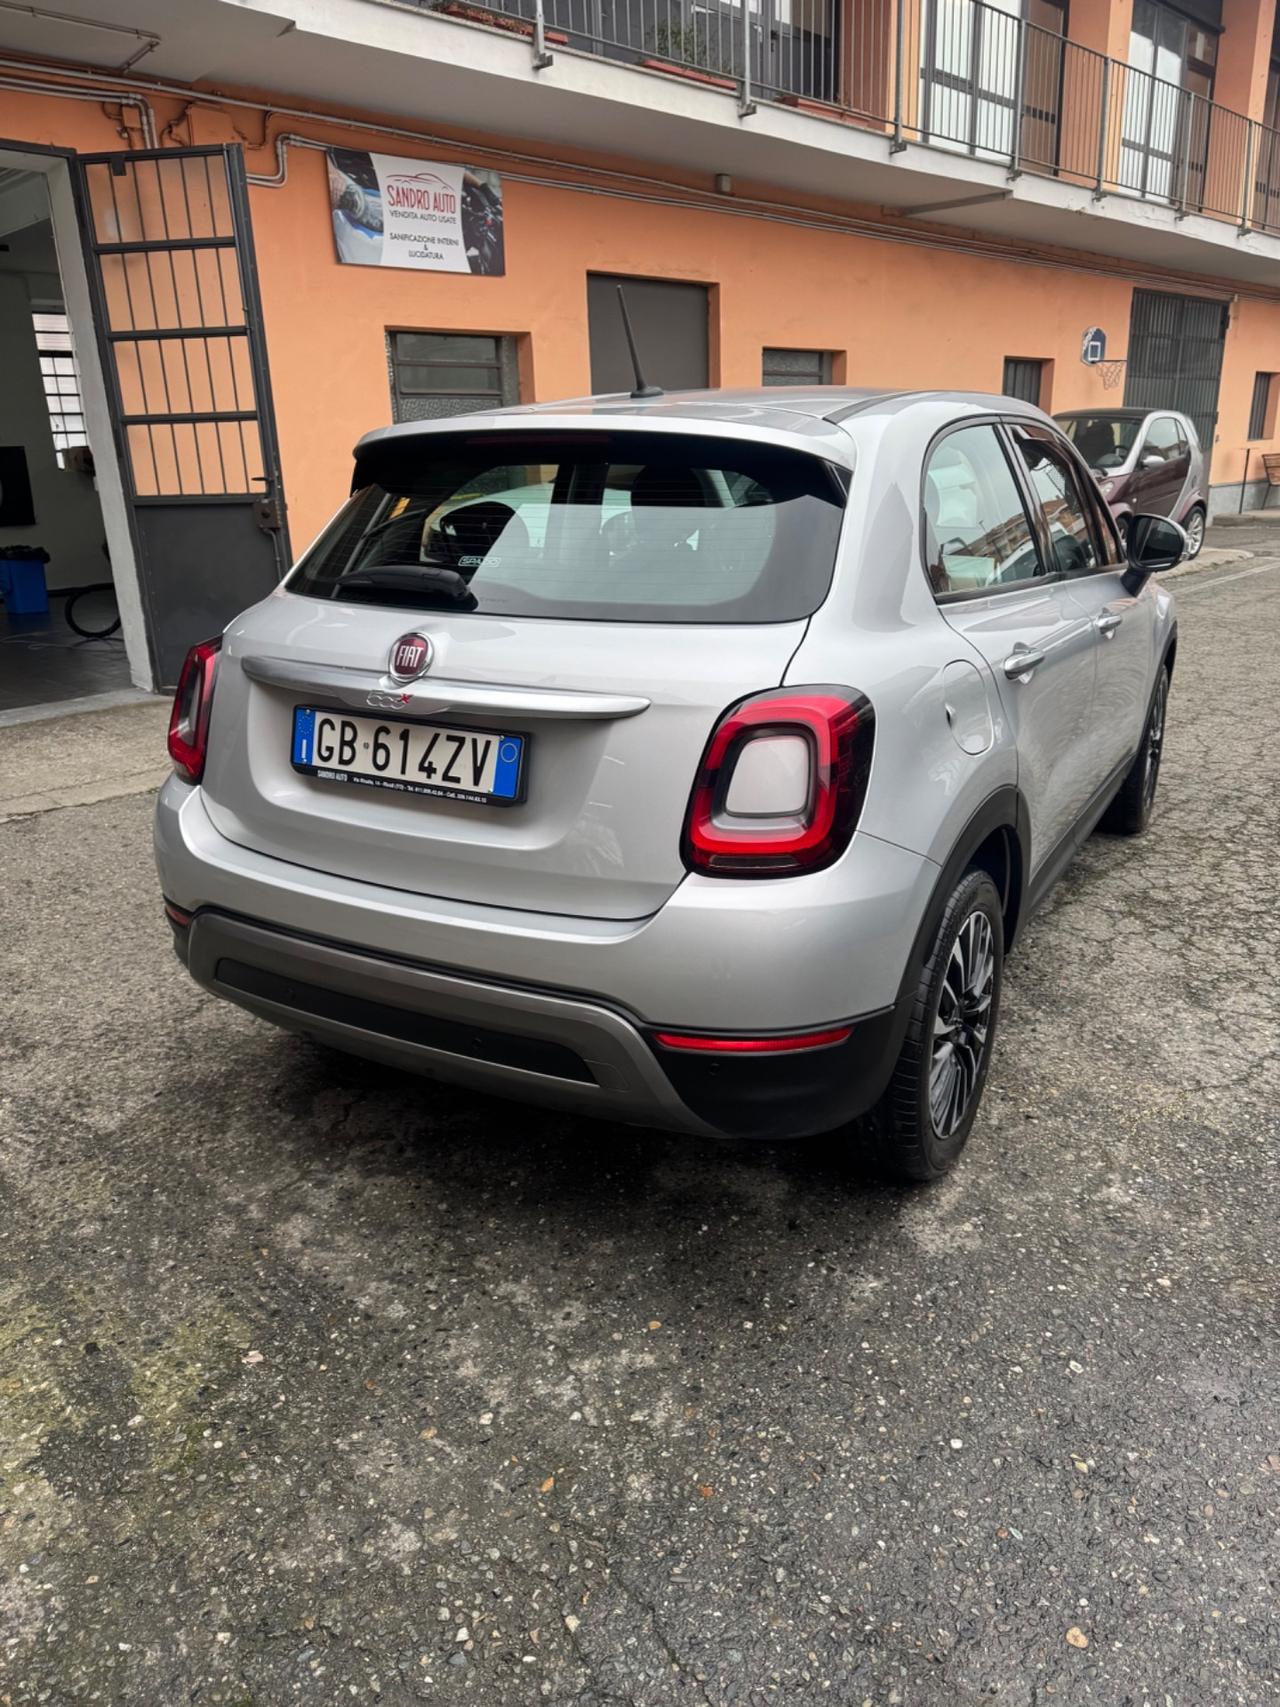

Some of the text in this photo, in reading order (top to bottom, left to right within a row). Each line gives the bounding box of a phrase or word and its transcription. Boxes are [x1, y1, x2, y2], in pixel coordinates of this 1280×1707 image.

[387, 184, 456, 214] SANDRO AUTO
[389, 209, 457, 224] VENDITA AUTO USATE
[389, 232, 459, 246] SANIFICAZIONE INTERNI
[408, 250, 444, 259] LUCIDATURA
[396, 645, 424, 667] FIAT
[317, 718, 491, 786] GB 614ZV
